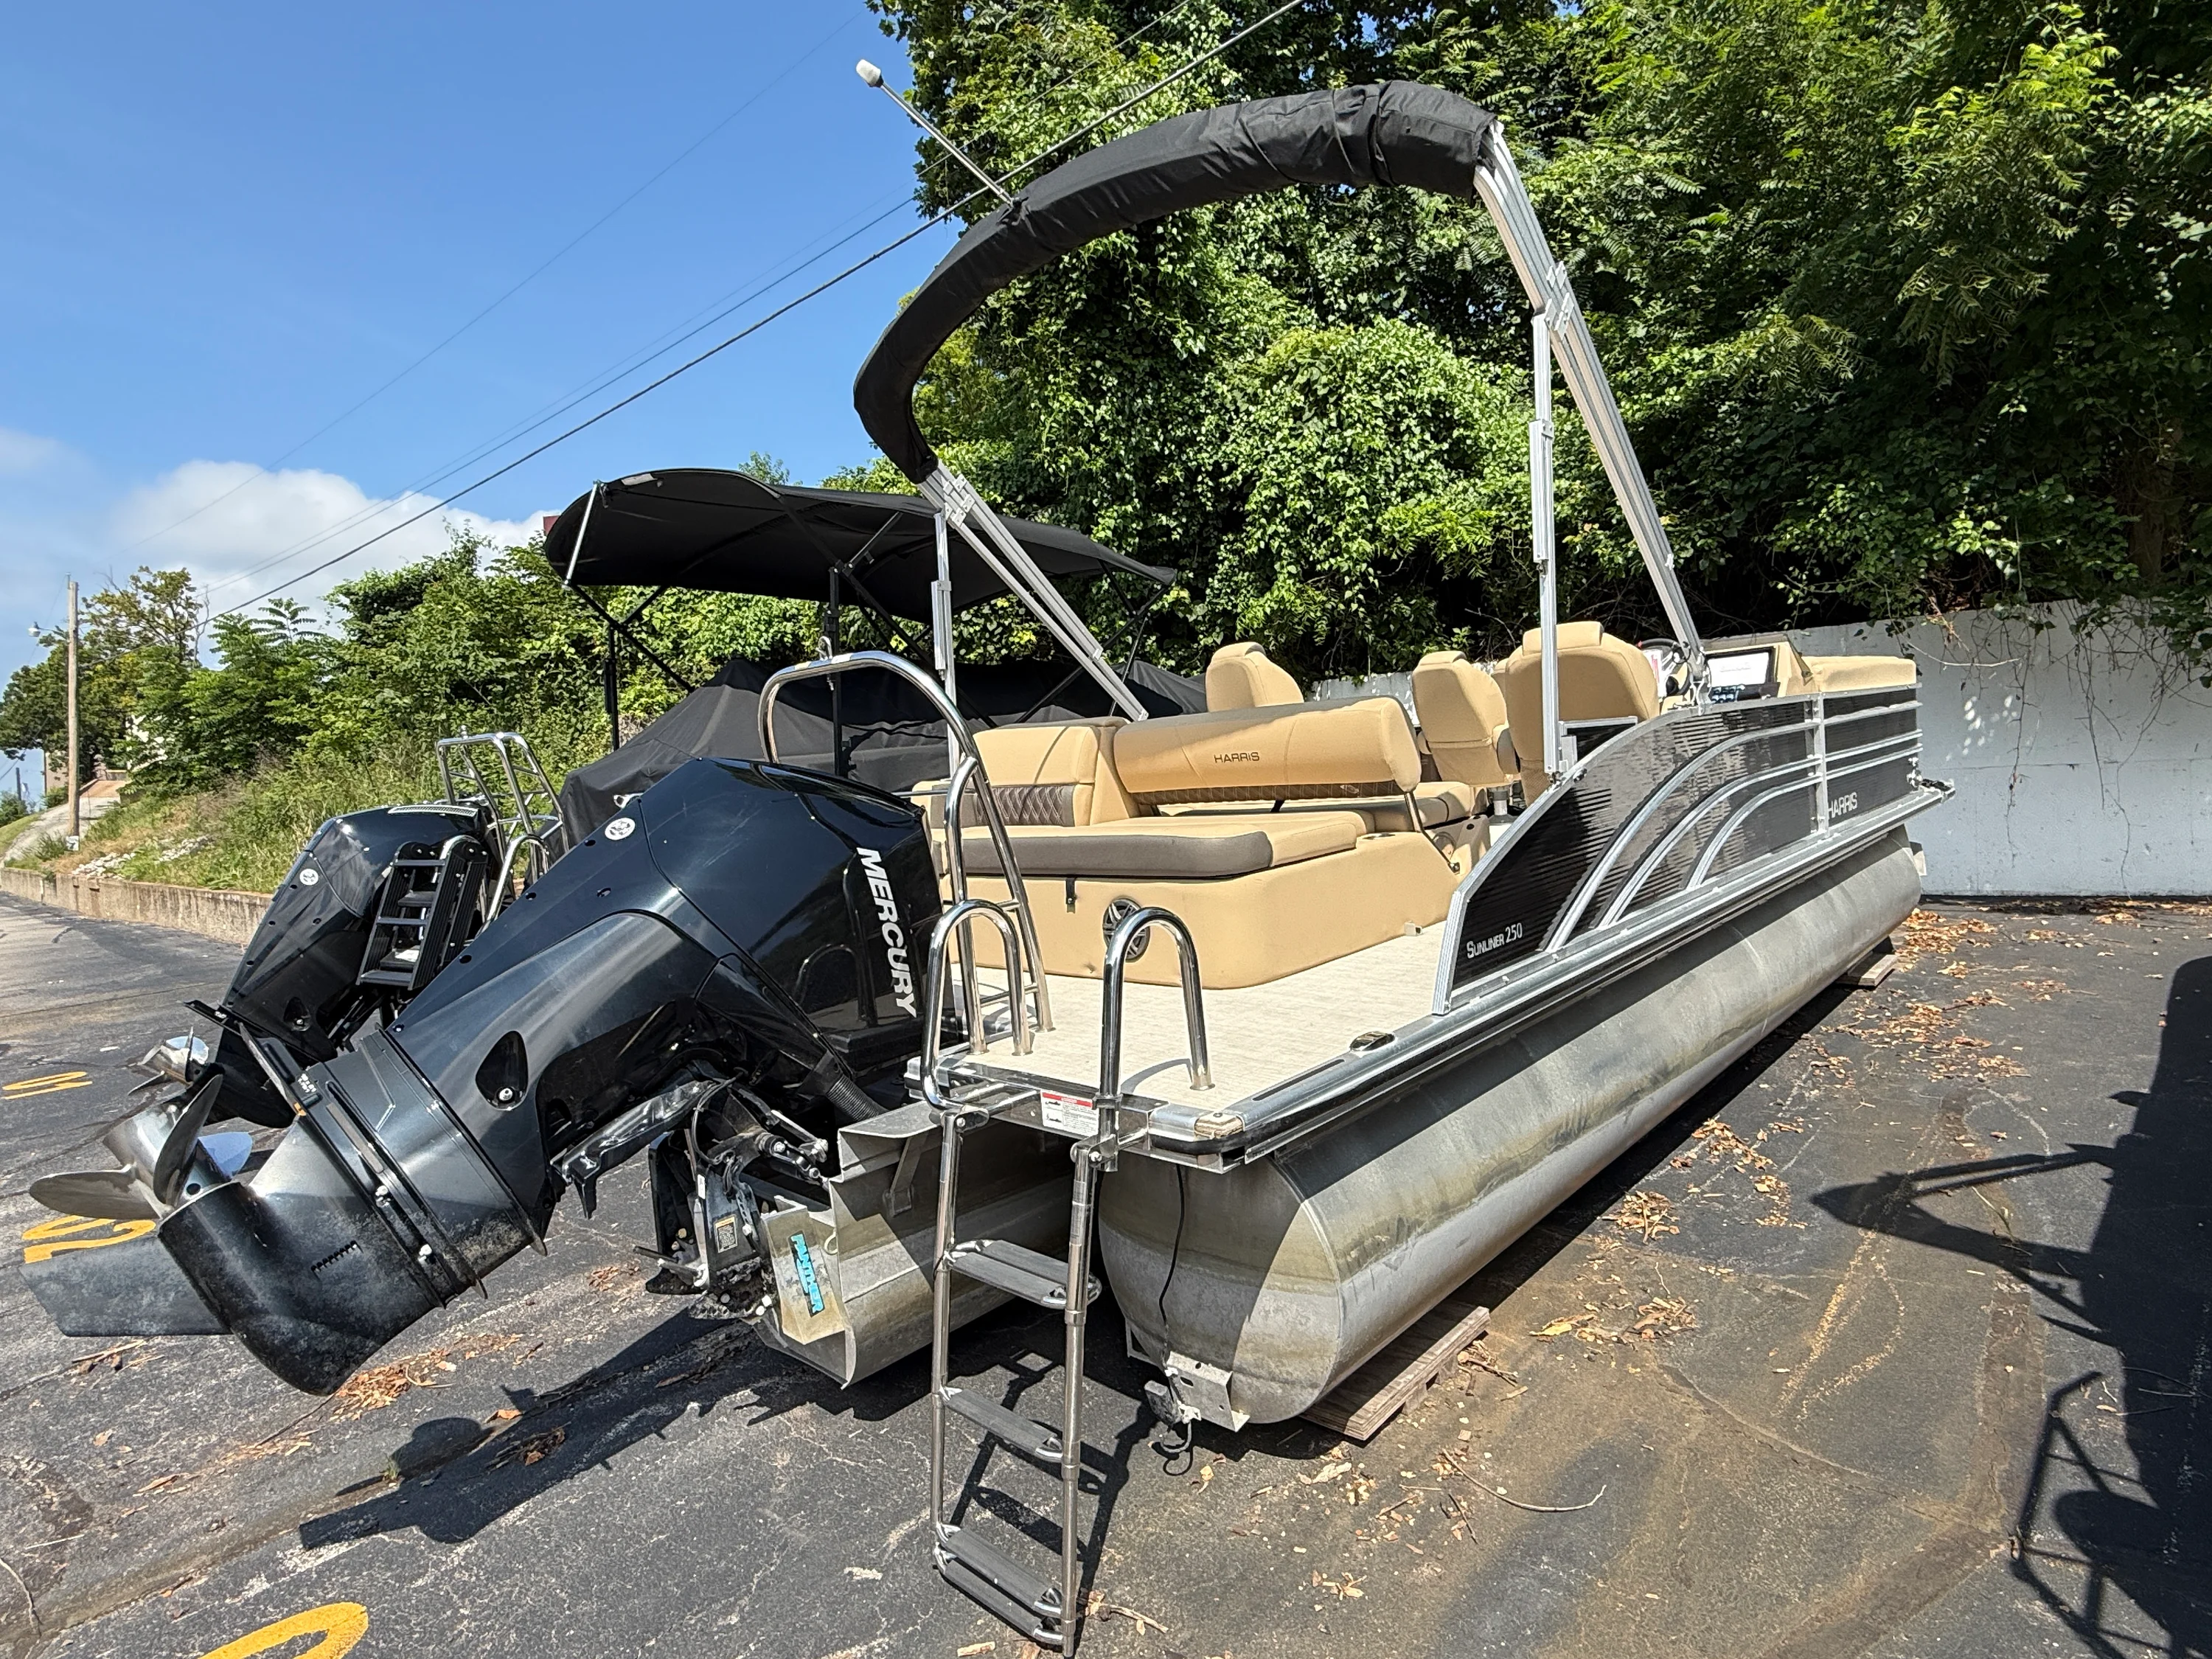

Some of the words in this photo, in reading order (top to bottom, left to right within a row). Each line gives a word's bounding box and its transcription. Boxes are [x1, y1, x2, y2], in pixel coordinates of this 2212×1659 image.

[1214, 751, 1260, 764] HARRIS
[856, 847, 917, 1018] MERCURY
[1505, 922, 1523, 944] 250
[790, 1233, 824, 1314] PANTHER
